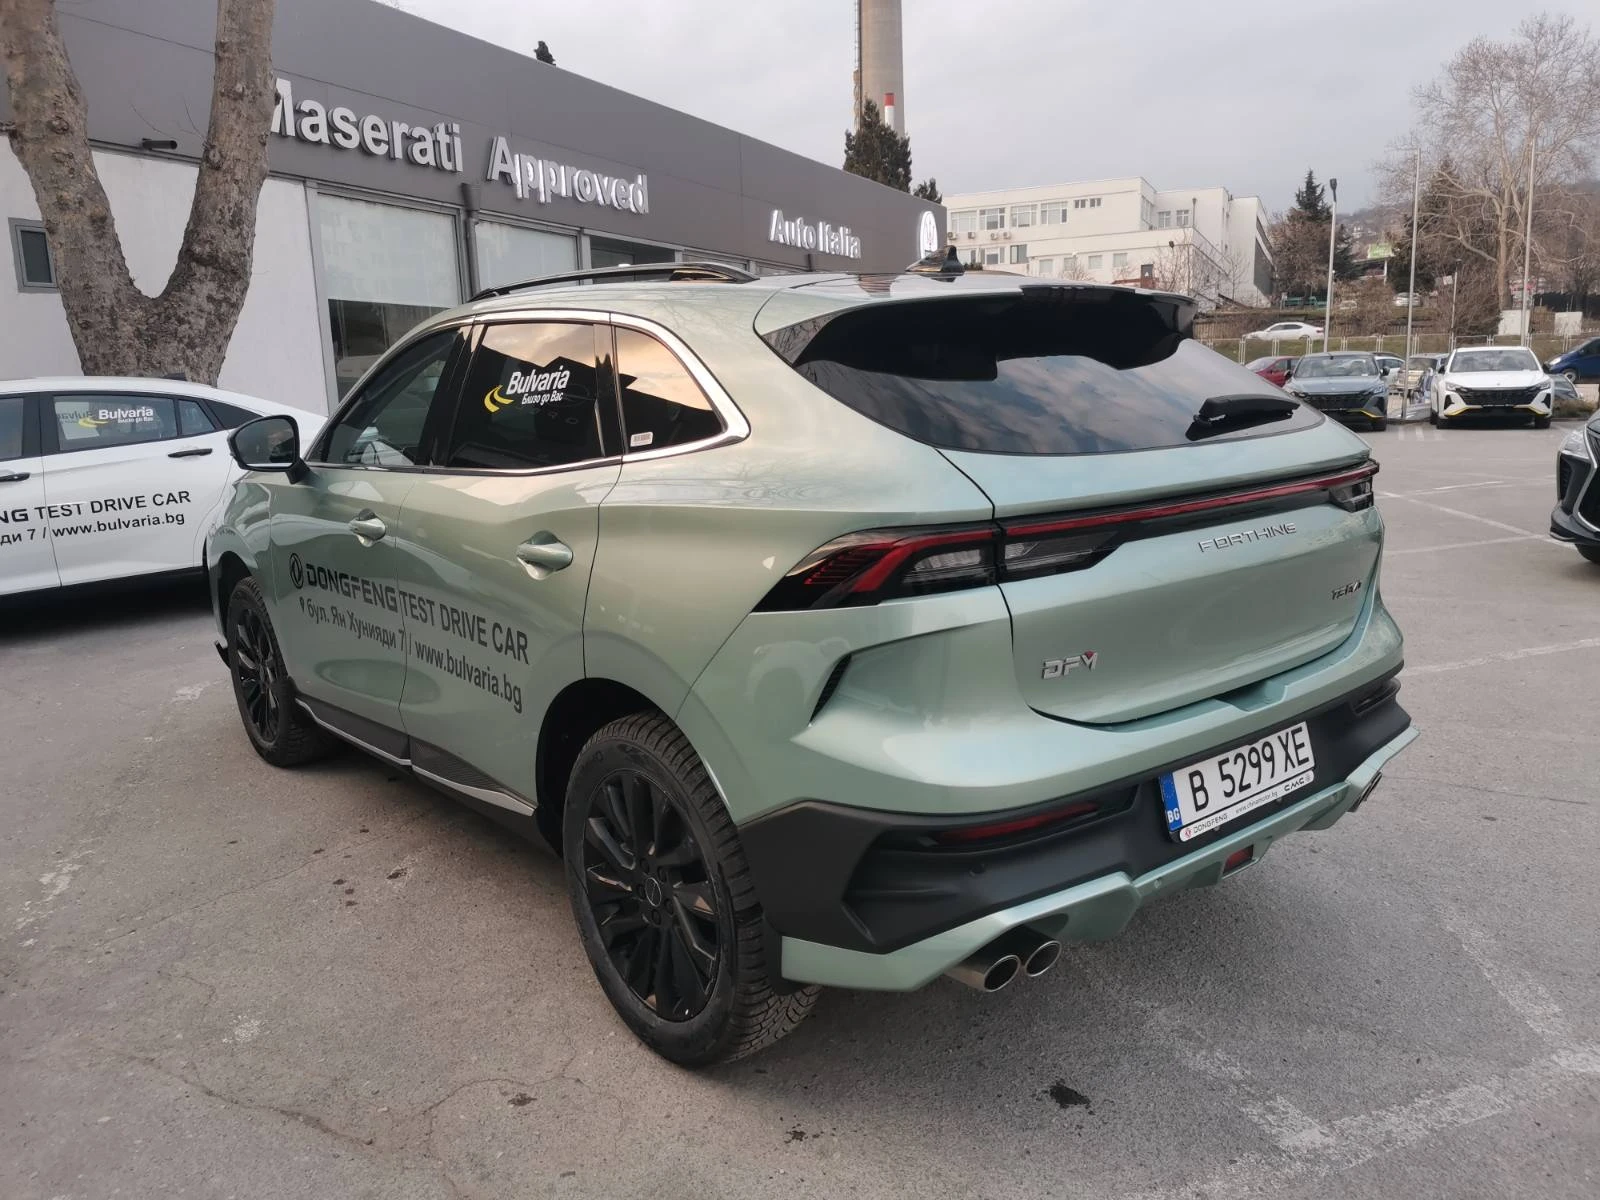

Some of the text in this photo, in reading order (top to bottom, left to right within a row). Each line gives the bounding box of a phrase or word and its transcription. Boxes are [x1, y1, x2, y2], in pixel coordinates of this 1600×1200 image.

[487, 136, 649, 214] Approved
[769, 210, 861, 259] Auto Italia
[506, 365, 570, 395] Bulvaria
[98, 405, 154, 420] Bulvaria
[34, 502, 83, 520] TEST
[90, 495, 147, 514] DRIVE
[152, 490, 192, 506] CAR
[27, 528, 36, 540] 7
[52, 511, 185, 538] www.bulvaria.bg
[305, 563, 529, 665] DONGFENG TEST DRIVE CAR
[307, 598, 329, 624] бул.
[331, 606, 346, 628] Ян
[349, 609, 397, 649] Хунияди
[414, 640, 523, 714] www.bulvaria.bg
[1188, 726, 1310, 812] B 5299 XE
[1167, 807, 1181, 823] BG
